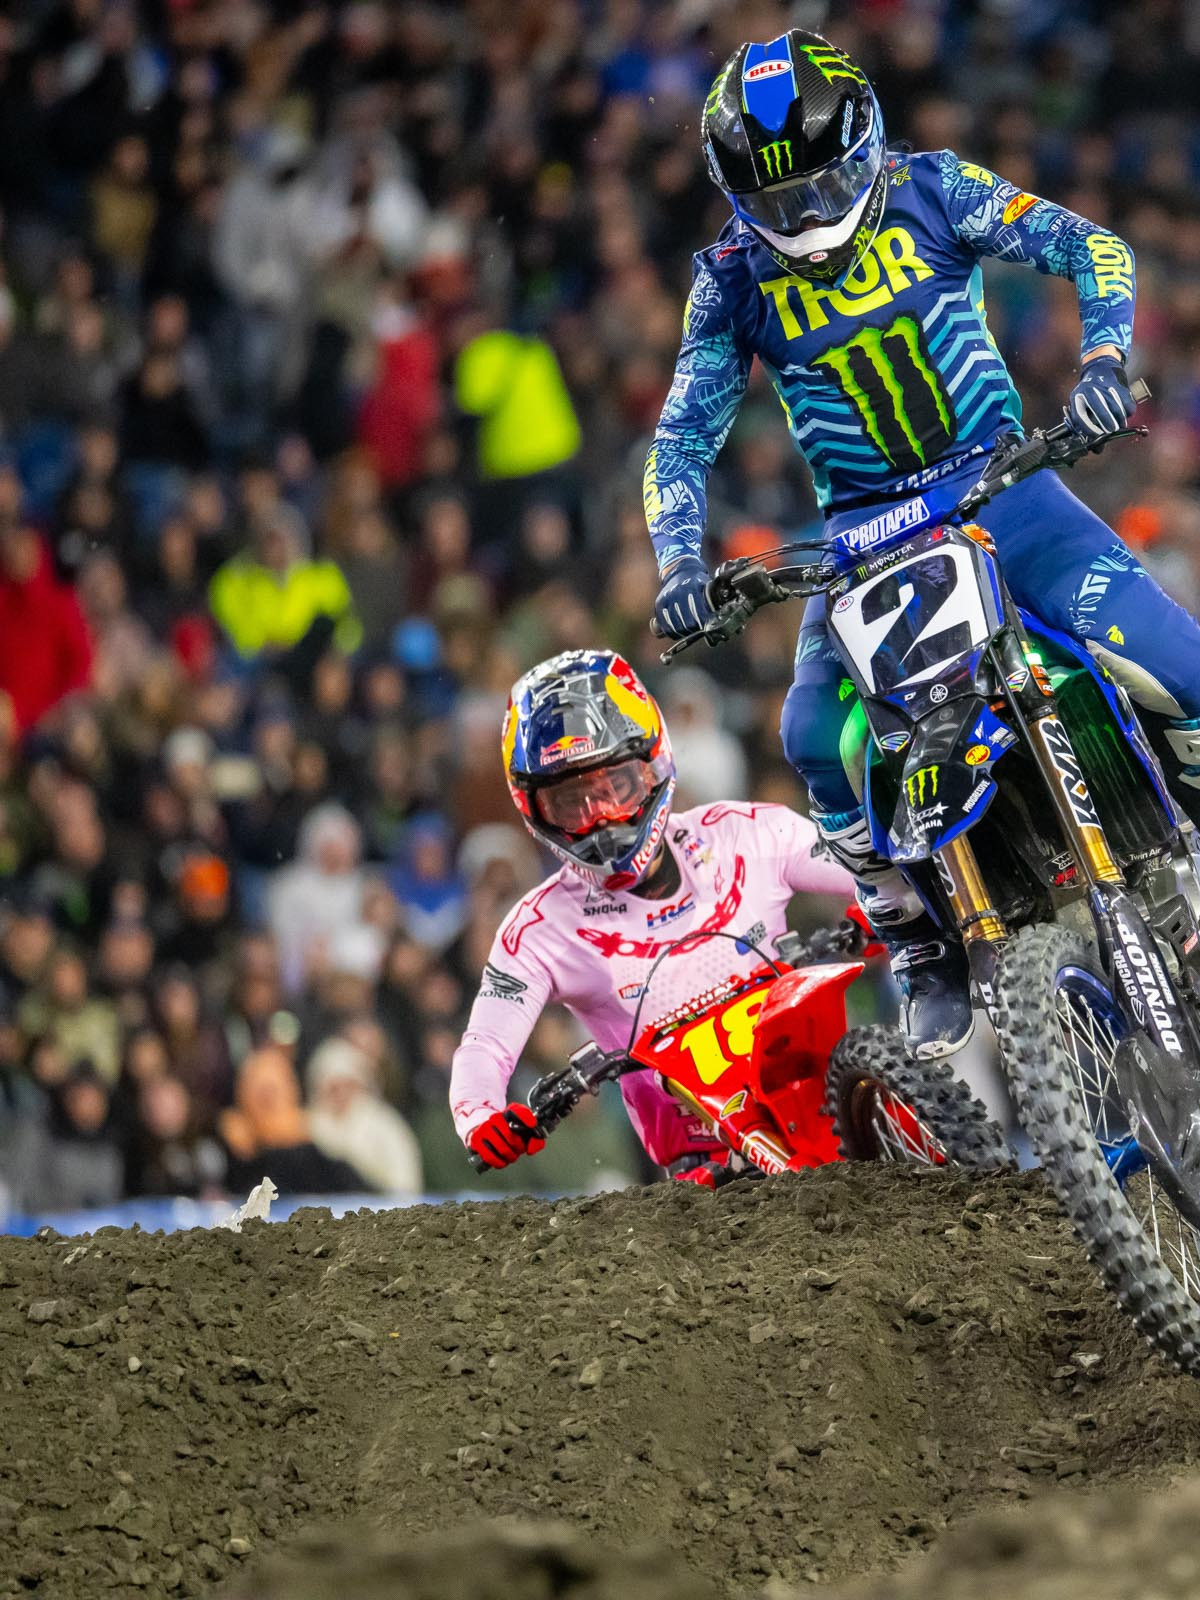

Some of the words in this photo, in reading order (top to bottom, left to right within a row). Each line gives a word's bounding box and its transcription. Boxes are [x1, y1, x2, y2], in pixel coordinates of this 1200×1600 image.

[750, 62, 786, 78] BELL
[811, 253, 826, 262] BELL
[1086, 233, 1133, 302] THOR
[759, 226, 935, 341] THOR
[849, 497, 925, 549] PROTAPER
[869, 543, 914, 571] MONSTER
[859, 553, 976, 696] 2
[1129, 853, 1148, 861] Twin
[1149, 848, 1162, 857] Air
[647, 893, 694, 928] HRC
[1113, 949, 1138, 997] CYCRA
[1117, 922, 1184, 1053] DUNLOP
[680, 988, 771, 1086] 18
